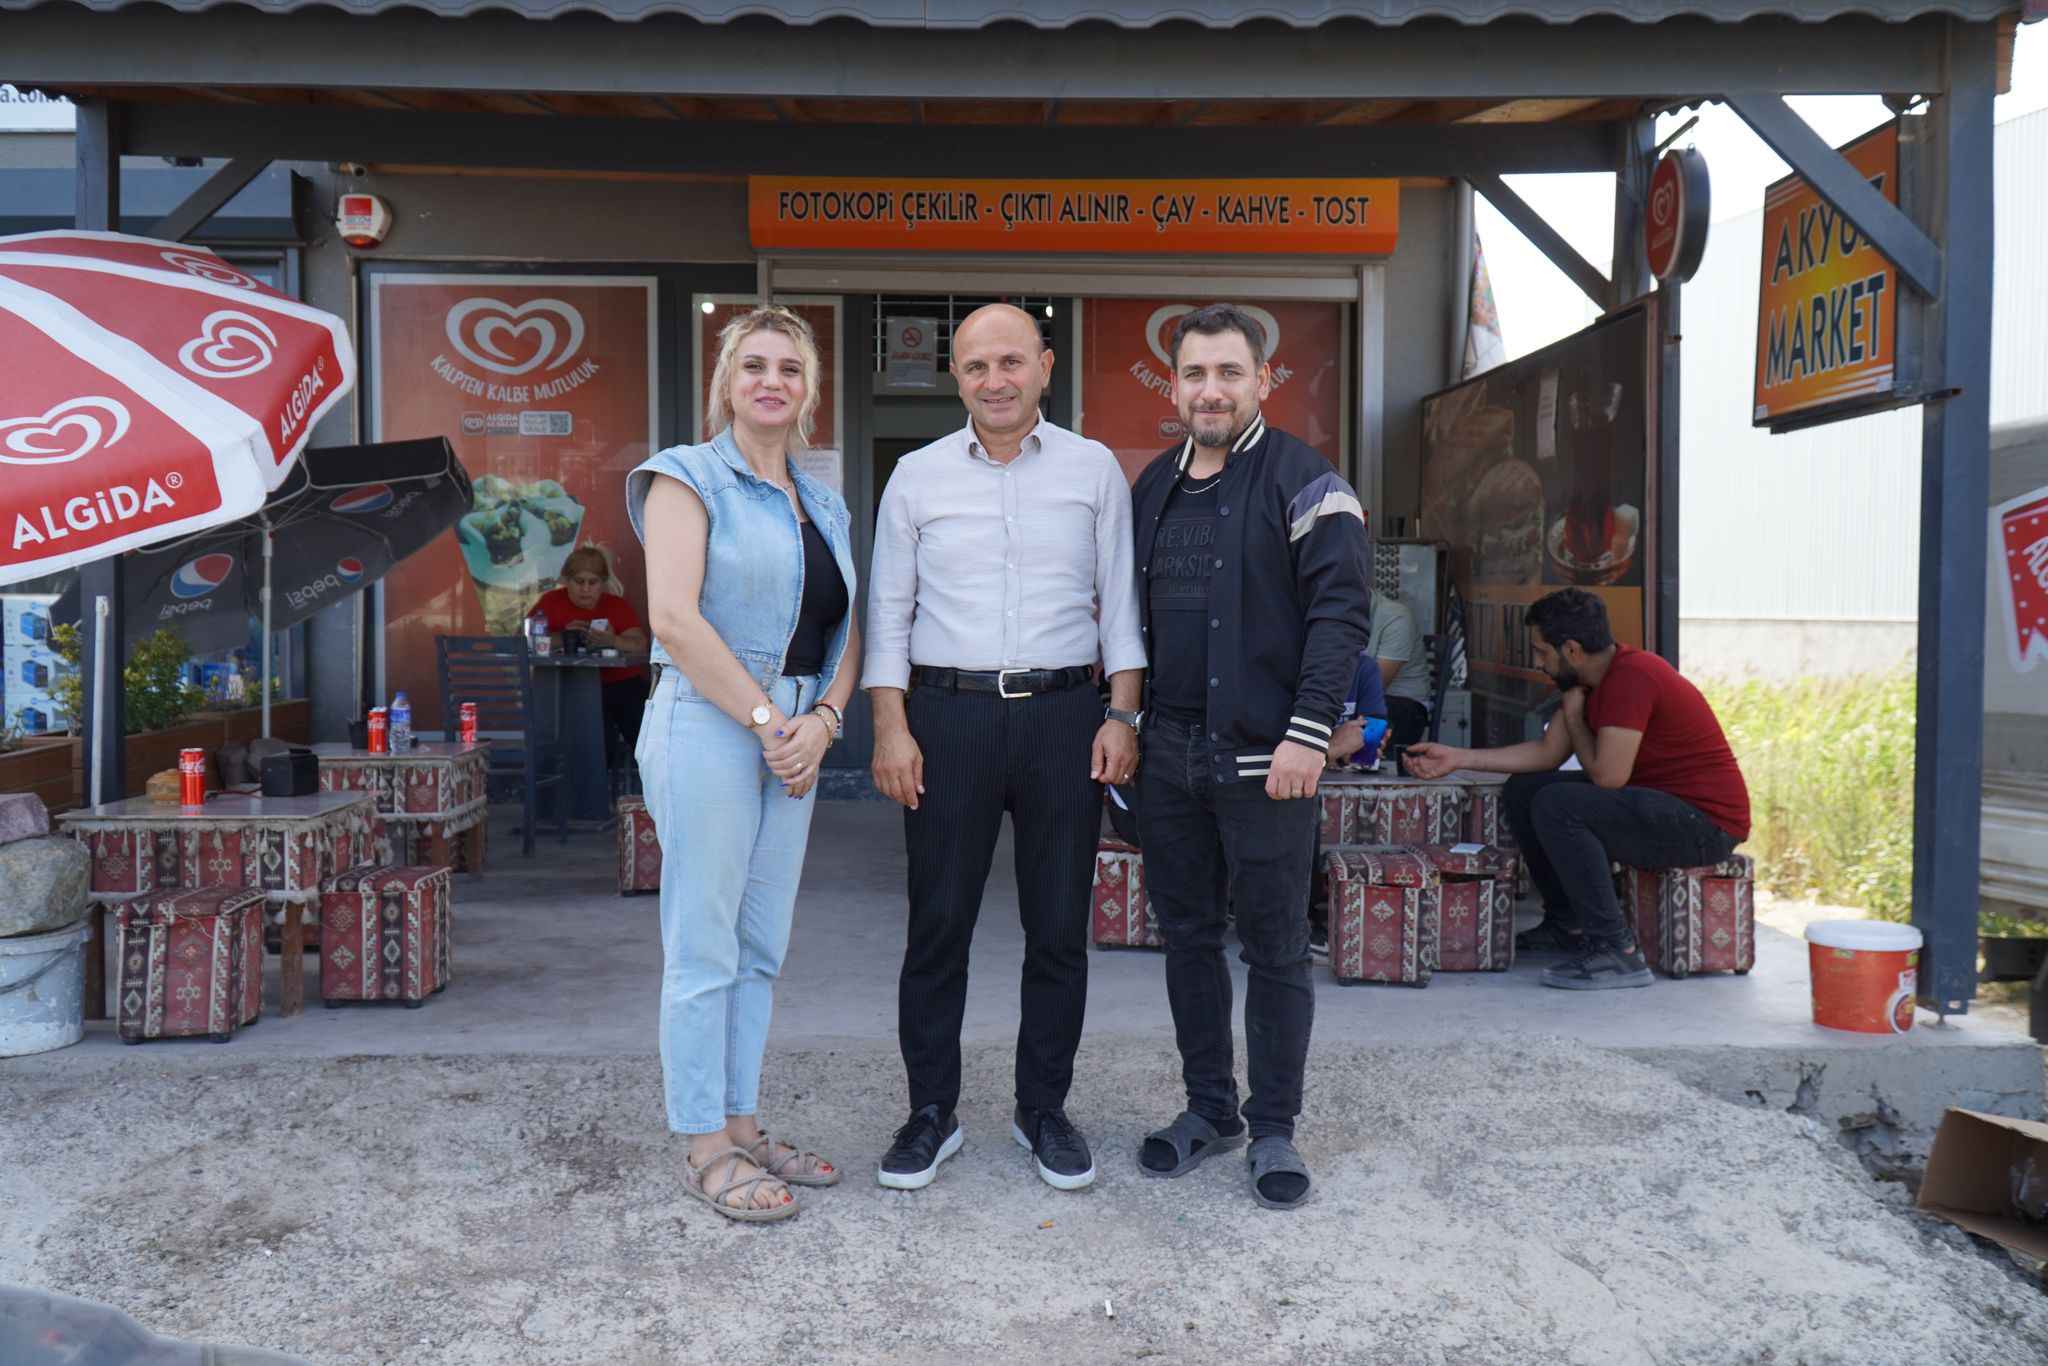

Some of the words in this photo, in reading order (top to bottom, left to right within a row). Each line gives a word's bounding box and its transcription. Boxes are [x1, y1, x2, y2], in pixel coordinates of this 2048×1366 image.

[1001, 192, 1051, 229] ÇIKTI
[1059, 193, 1130, 222] ALINIR
[1152, 194, 1196, 231] ÇAY
[1217, 196, 1290, 224] KAHVE
[1313, 197, 1369, 225] TOST
[1764, 272, 1886, 388] MARKET
[430, 354, 485, 397] KALPTEN
[487, 383, 530, 403] KALBE
[534, 357, 600, 401] MUTLULUK
[1129, 360, 1172, 399] KALPTE
